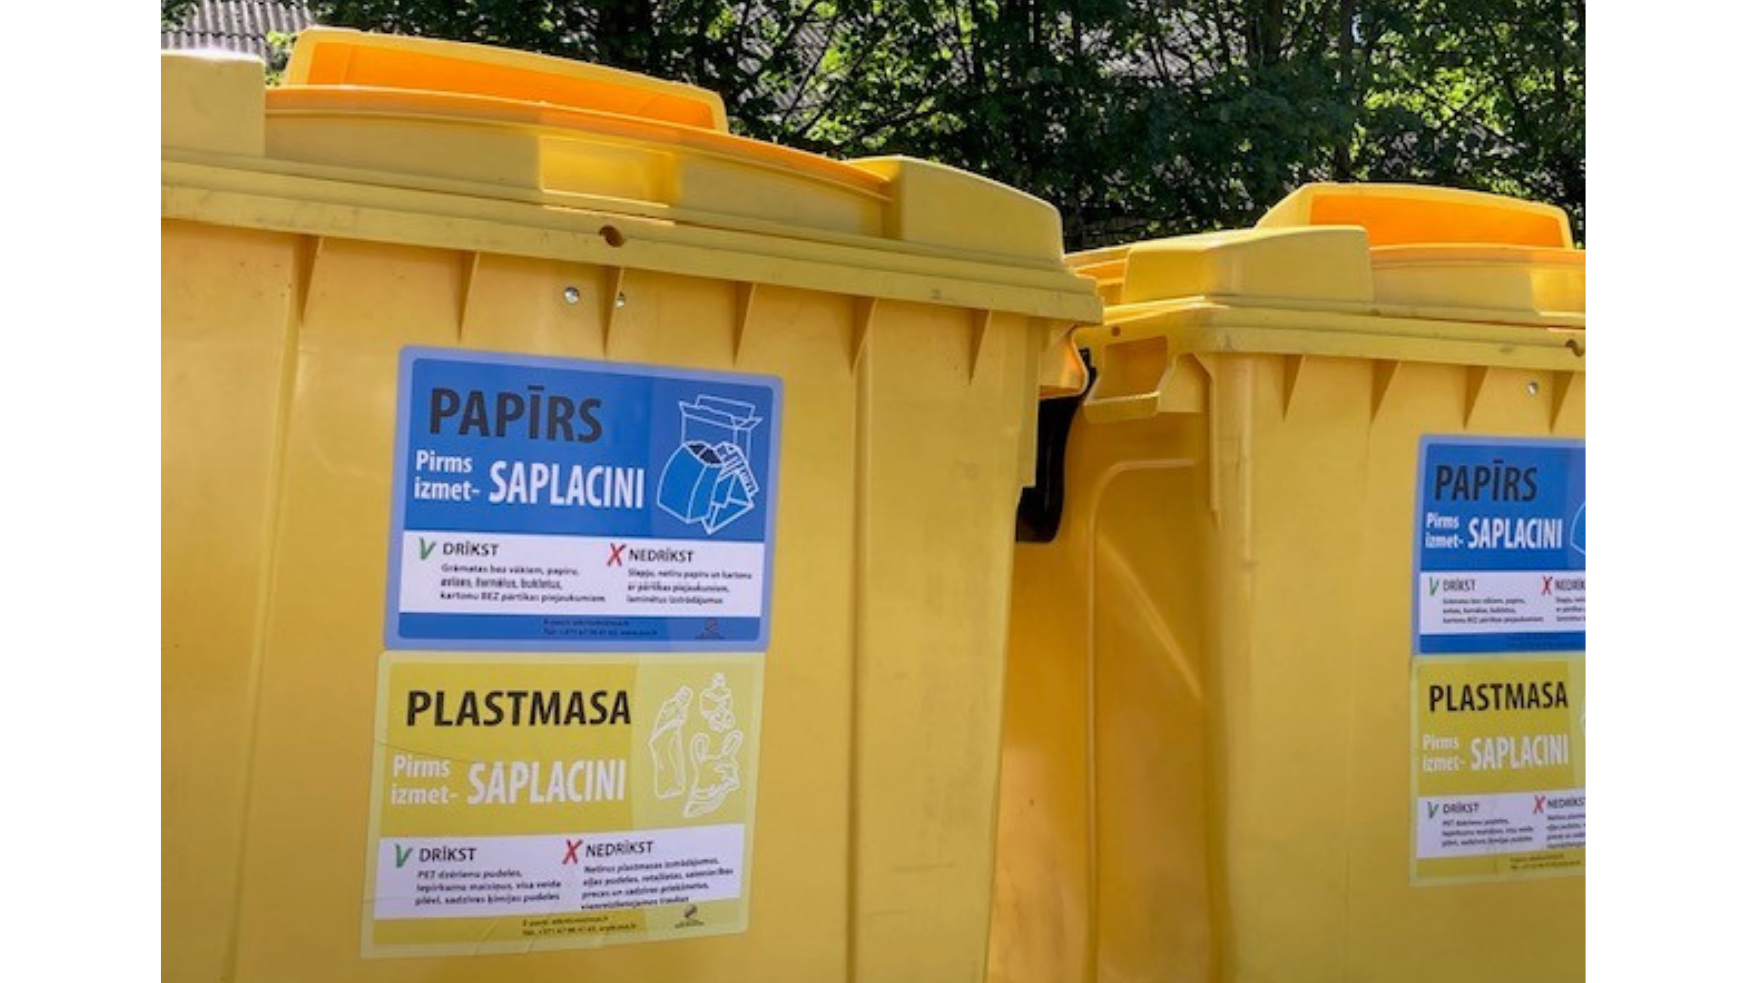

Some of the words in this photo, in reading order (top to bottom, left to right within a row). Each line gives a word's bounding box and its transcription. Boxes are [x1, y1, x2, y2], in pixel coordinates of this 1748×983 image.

[430, 385, 603, 443] PAPĪRS
[415, 449, 473, 474] Pirms
[414, 477, 480, 501] izmet-
[489, 461, 645, 510] SAPLACINI
[1434, 458, 1538, 502] PAPĪRS
[1426, 512, 1460, 529] Pirms
[1468, 517, 1562, 549] SAPLACINI
[443, 541, 499, 557] DRĪKST
[628, 547, 695, 563] NEDRĪKST
[481, 592, 499, 601] BEZ
[406, 690, 632, 727] PLASTMASA
[1429, 682, 1568, 712] PLASTMASA
[1422, 734, 1459, 751] Pirms
[1471, 734, 1568, 771] SAPLACINI
[394, 754, 451, 779] Pirms
[390, 783, 459, 806] izmet-
[467, 758, 626, 805] SAPLACINI
[419, 845, 477, 862] DRĪKST
[585, 840, 654, 858] NEDRĪKST
[417, 870, 436, 879] PET
